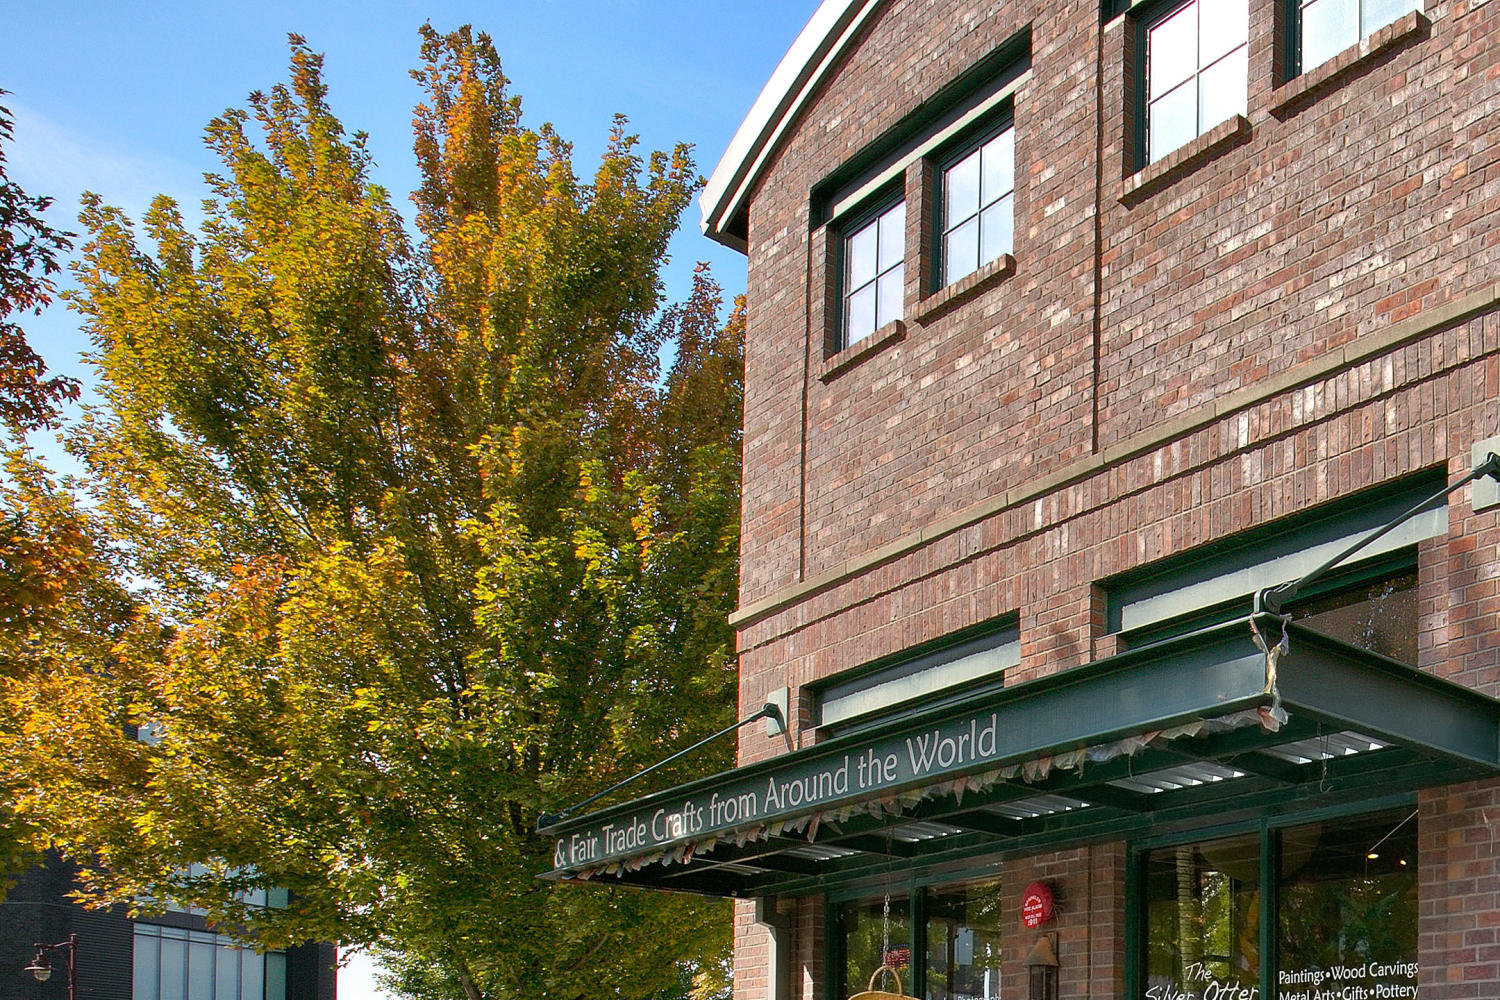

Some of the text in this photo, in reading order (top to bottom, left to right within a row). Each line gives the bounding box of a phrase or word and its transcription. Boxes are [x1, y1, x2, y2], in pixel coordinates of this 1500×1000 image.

[554, 713, 998, 868] & Fair Trade Crafts from Around the World
[1185, 961, 1213, 982] The
[1278, 960, 1419, 986] Paintings Wood Carvings
[1376, 983, 1419, 1000] Pottery
